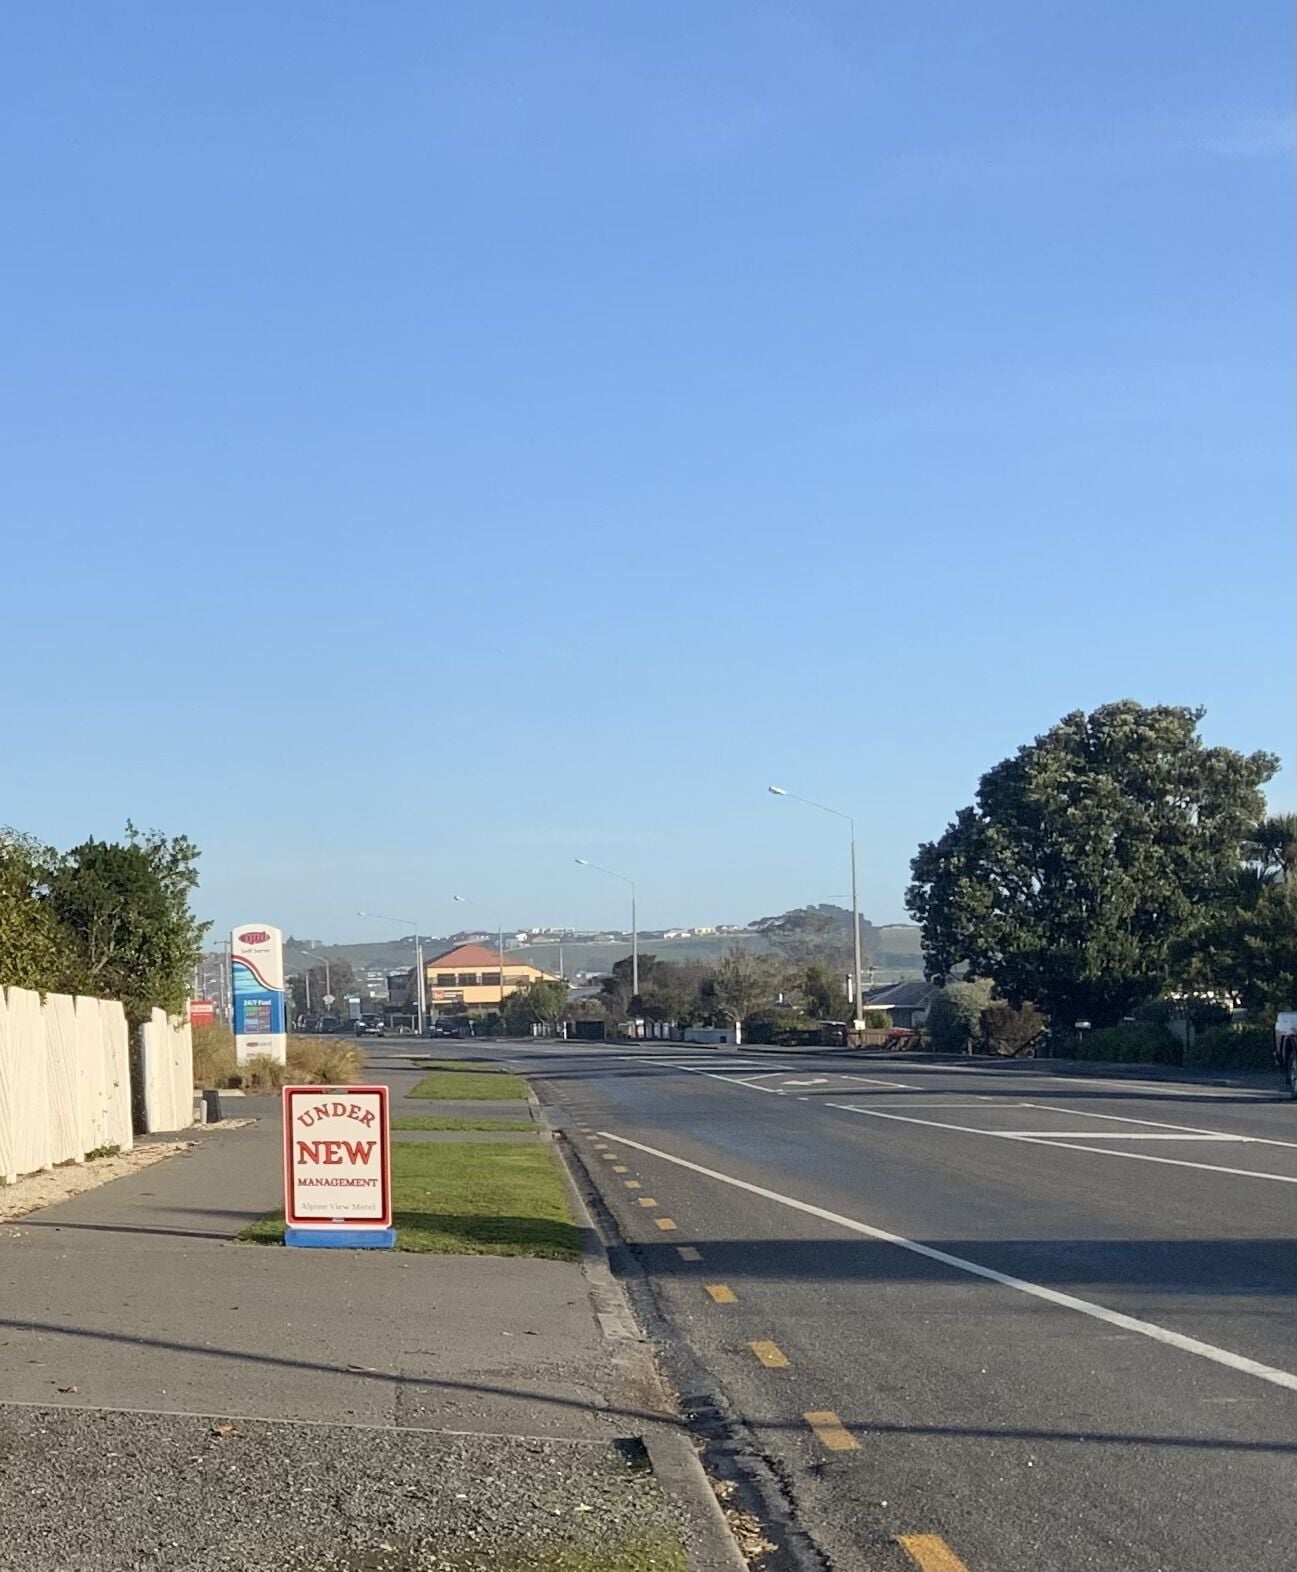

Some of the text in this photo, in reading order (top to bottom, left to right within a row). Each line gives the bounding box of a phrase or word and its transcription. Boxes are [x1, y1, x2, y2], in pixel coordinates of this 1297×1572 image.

[297, 1102, 376, 1128] UNDER
[296, 1140, 377, 1165] NEW
[297, 1177, 378, 1187] MANAGEMENT
